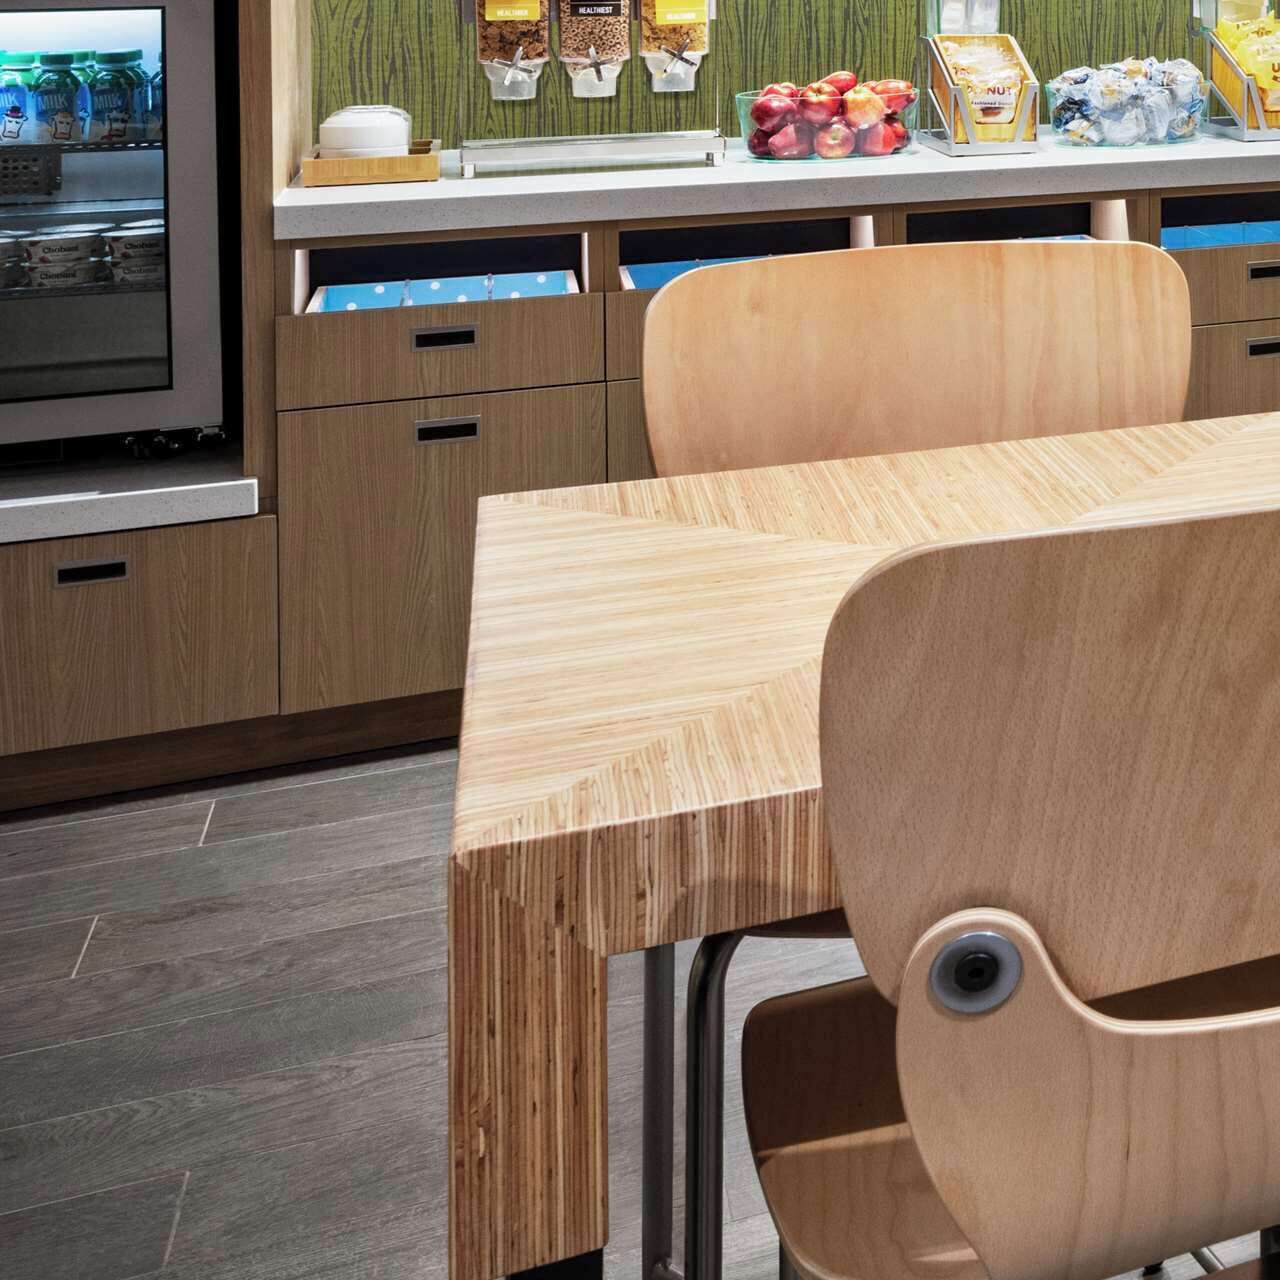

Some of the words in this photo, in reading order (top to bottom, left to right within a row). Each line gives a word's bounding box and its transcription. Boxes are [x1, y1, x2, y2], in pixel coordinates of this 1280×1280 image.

[579, 6, 613, 15] HEALTHIEST
[37, 94, 68, 111] MILK
[94, 93, 122, 110] MILK
[42, 244, 79, 254] Chobani
